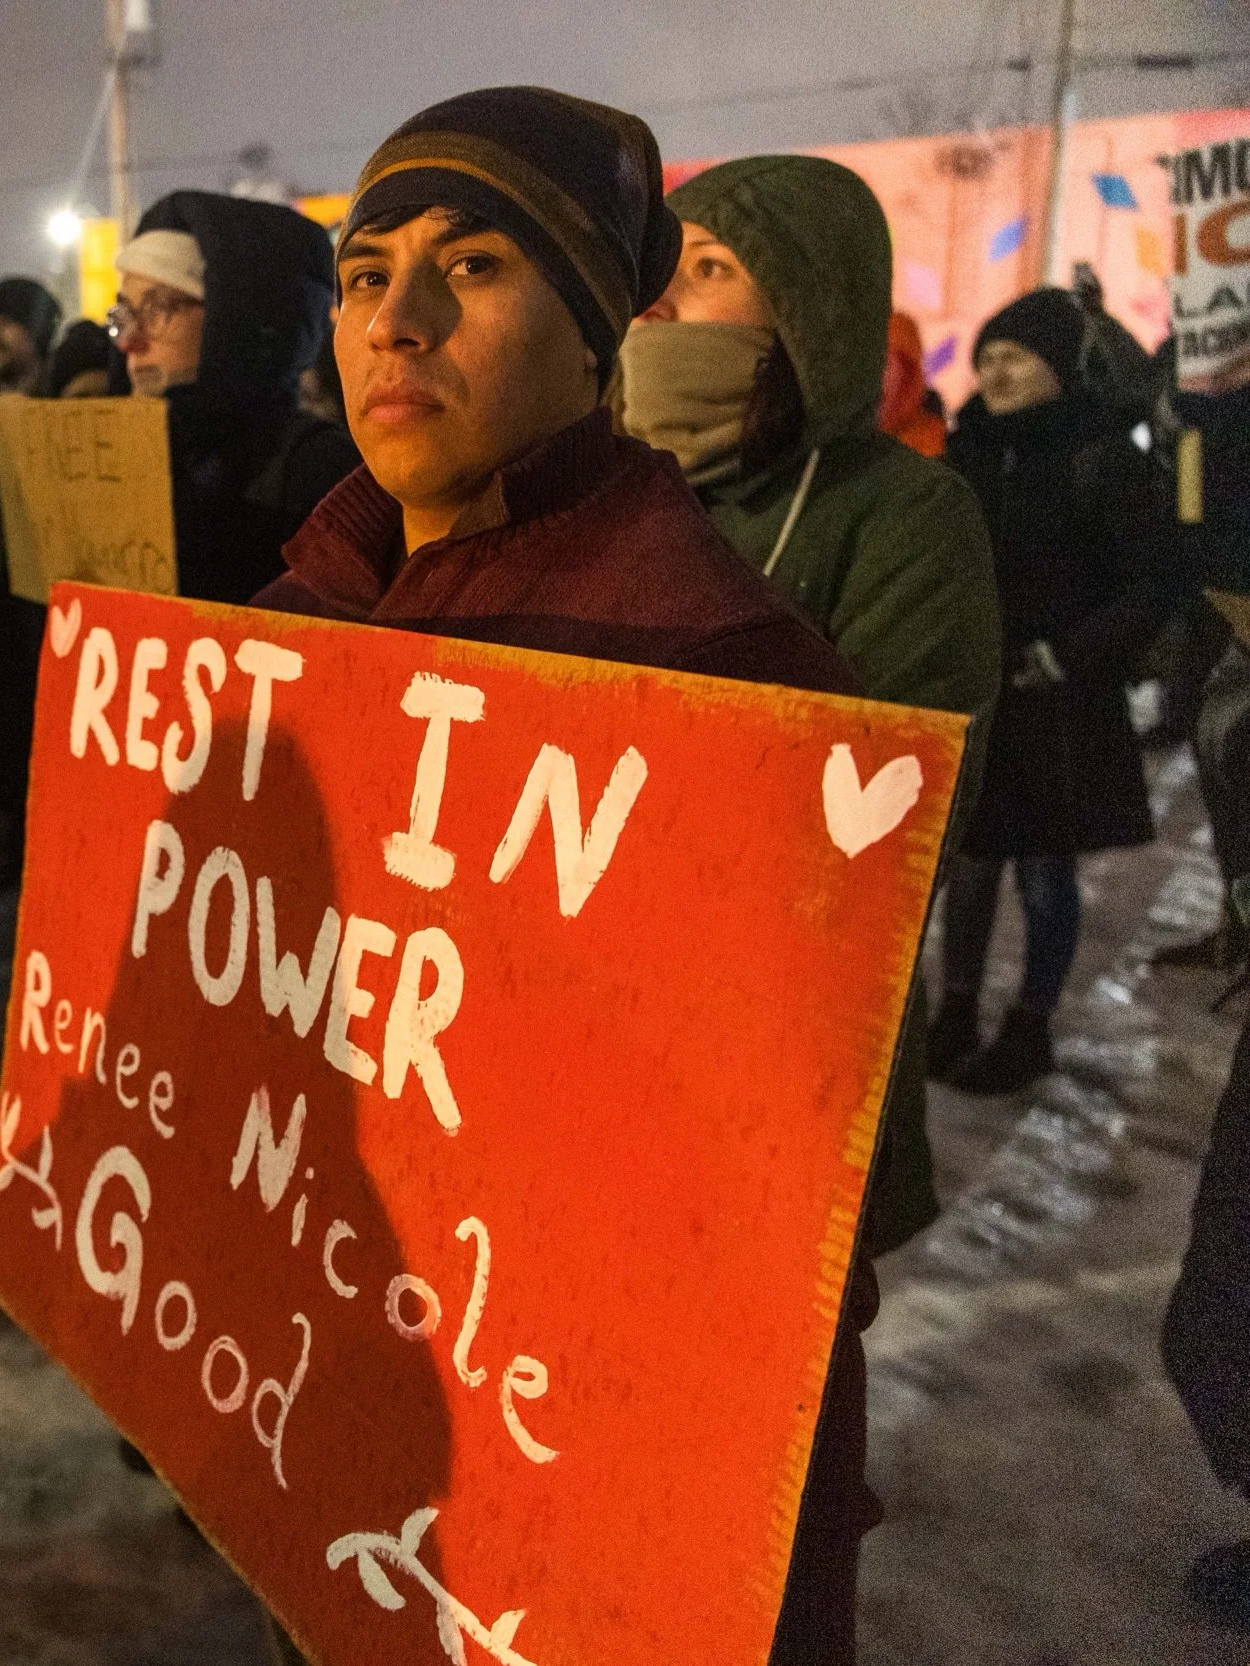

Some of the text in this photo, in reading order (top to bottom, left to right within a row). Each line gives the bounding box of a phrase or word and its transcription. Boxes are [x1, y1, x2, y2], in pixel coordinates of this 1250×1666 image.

[70, 627, 648, 918] REST IN
[132, 820, 464, 1135] POWER
[20, 951, 560, 1464] Renee Nicole
[76, 1146, 311, 1489] Good
